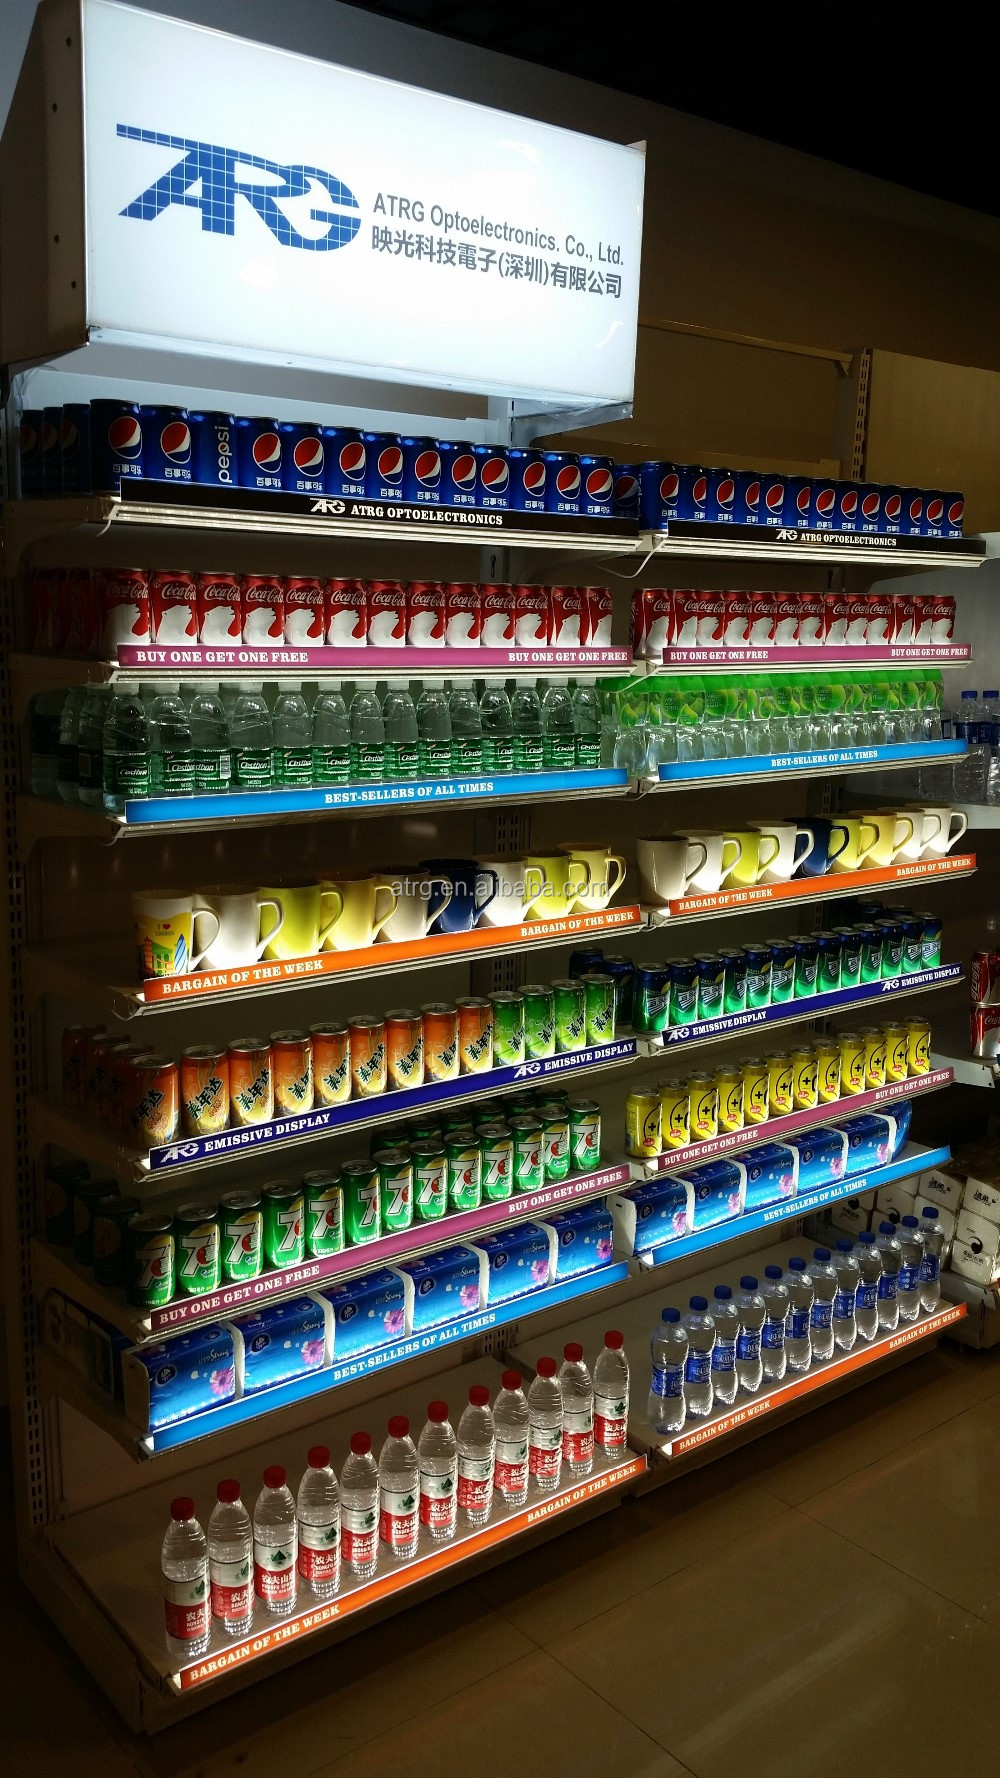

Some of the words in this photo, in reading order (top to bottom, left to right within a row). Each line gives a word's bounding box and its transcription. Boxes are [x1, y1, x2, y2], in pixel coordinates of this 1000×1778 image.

[374, 193, 425, 222] ATRG
[566, 235, 593, 260] Co.,
[599, 242, 623, 266] Ltd.
[218, 426, 232, 483] pepsi
[351, 505, 384, 517] ATRG
[387, 507, 503, 525] OPTOELECTRONICS
[801, 533, 821, 542] ATRG
[824, 534, 896, 546] OPTOELECTRONICS
[137, 651, 166, 662] BUY
[171, 652, 202, 662] ONE
[206, 652, 235, 662] GET
[239, 652, 268, 662] ONE
[272, 652, 308, 662] FREE
[509, 653, 529, 662] BUY
[532, 652, 553, 662] ONE
[556, 652, 576, 661] GET
[579, 652, 600, 661] ONE
[602, 652, 627, 661] FREE
[670, 652, 688, 660] BUY
[690, 652, 708, 660] ONE
[710, 651, 726, 660] GET
[728, 651, 744, 659] ONE
[746, 651, 768, 659] FREE
[935, 648, 950, 656] ONE
[771, 754, 828, 767] BEST-SELLERS
[830, 754, 838, 762] OF
[840, 753, 853, 761] ALL
[855, 750, 878, 760] TIMES
[325, 787, 415, 804] BEST-SELLERS
[417, 786, 432, 797] OF
[435, 784, 456, 795] ALL
[458, 782, 494, 794] TIMES
[897, 866, 926, 876] BARGAIN
[938, 862, 951, 870] THE
[952, 858, 971, 867] WEEK
[679, 896, 717, 910] BARGAIN
[719, 895, 729, 904] OF
[732, 893, 747, 902] THE
[750, 889, 773, 900] WEEK
[521, 922, 566, 937] BARGAIN
[569, 919, 581, 929] OF
[584, 916, 604, 926] THE
[606, 912, 634, 923] WEEK
[163, 975, 227, 994] BARGAIN
[231, 972, 250, 982] OF
[253, 967, 281, 979] THE
[286, 960, 323, 977] WEEK
[901, 972, 934, 987] EMISSIVE
[935, 966, 960, 980] DISPLAY
[692, 1019, 733, 1036] EMISSIVE
[734, 1011, 767, 1026] DISPLAY
[545, 1052, 592, 1071] EMISSIVE
[595, 1042, 633, 1059] DISPLAY
[185, 1077, 224, 1120] 美年达
[236, 1069, 269, 1110] 美年达
[875, 1090, 888, 1100] BUY
[889, 1087, 904, 1096] ONE
[905, 1083, 917, 1092] GET
[919, 1079, 932, 1087] ONE
[933, 1072, 950, 1083] FREE
[205, 1127, 272, 1152] EMISSIVE
[276, 1114, 331, 1135] DISPLAY
[664, 1155, 682, 1165] BUY
[683, 1148, 700, 1159] ONE
[702, 1143, 718, 1153] GET
[720, 1138, 736, 1148] ONE
[737, 1130, 758, 1142] FREE
[509, 1199, 530, 1213] BUY
[531, 1193, 552, 1206] ONE
[553, 1187, 573, 1200] GET
[575, 1181, 596, 1193] ONE
[597, 1171, 622, 1187] FREE
[764, 1197, 818, 1221] BEST-SELLERS
[820, 1190, 829, 1201] OF
[830, 1186, 843, 1197] ALL
[845, 1178, 867, 1194] TIMES
[159, 1308, 187, 1325] BUY
[190, 1298, 220, 1314] ONE
[223, 1288, 250, 1304] GET
[255, 1277, 283, 1293] ONE
[285, 1265, 320, 1284] FREE
[889, 1330, 918, 1348] BARGAIN
[919, 1326, 927, 1336] OF
[929, 1319, 942, 1331] THE
[942, 1310, 961, 1325] WEEK
[334, 1341, 420, 1380] BEST-SELLERS
[422, 1334, 437, 1345] OF
[439, 1326, 459, 1340] ALL
[462, 1313, 496, 1332] TIMES
[679, 1429, 716, 1450] BARGAIN
[718, 1421, 728, 1431] OF
[730, 1412, 746, 1426] THE
[748, 1400, 771, 1418] WEEK
[527, 1495, 571, 1522] BARGAIN
[573, 1490, 586, 1500] OF
[588, 1479, 607, 1493] THE
[609, 1464, 637, 1483] WEEK
[190, 1645, 251, 1680] BARGAIN
[253, 1636, 270, 1651] OF
[274, 1623, 300, 1642] THE
[303, 1604, 341, 1628] WEEK
